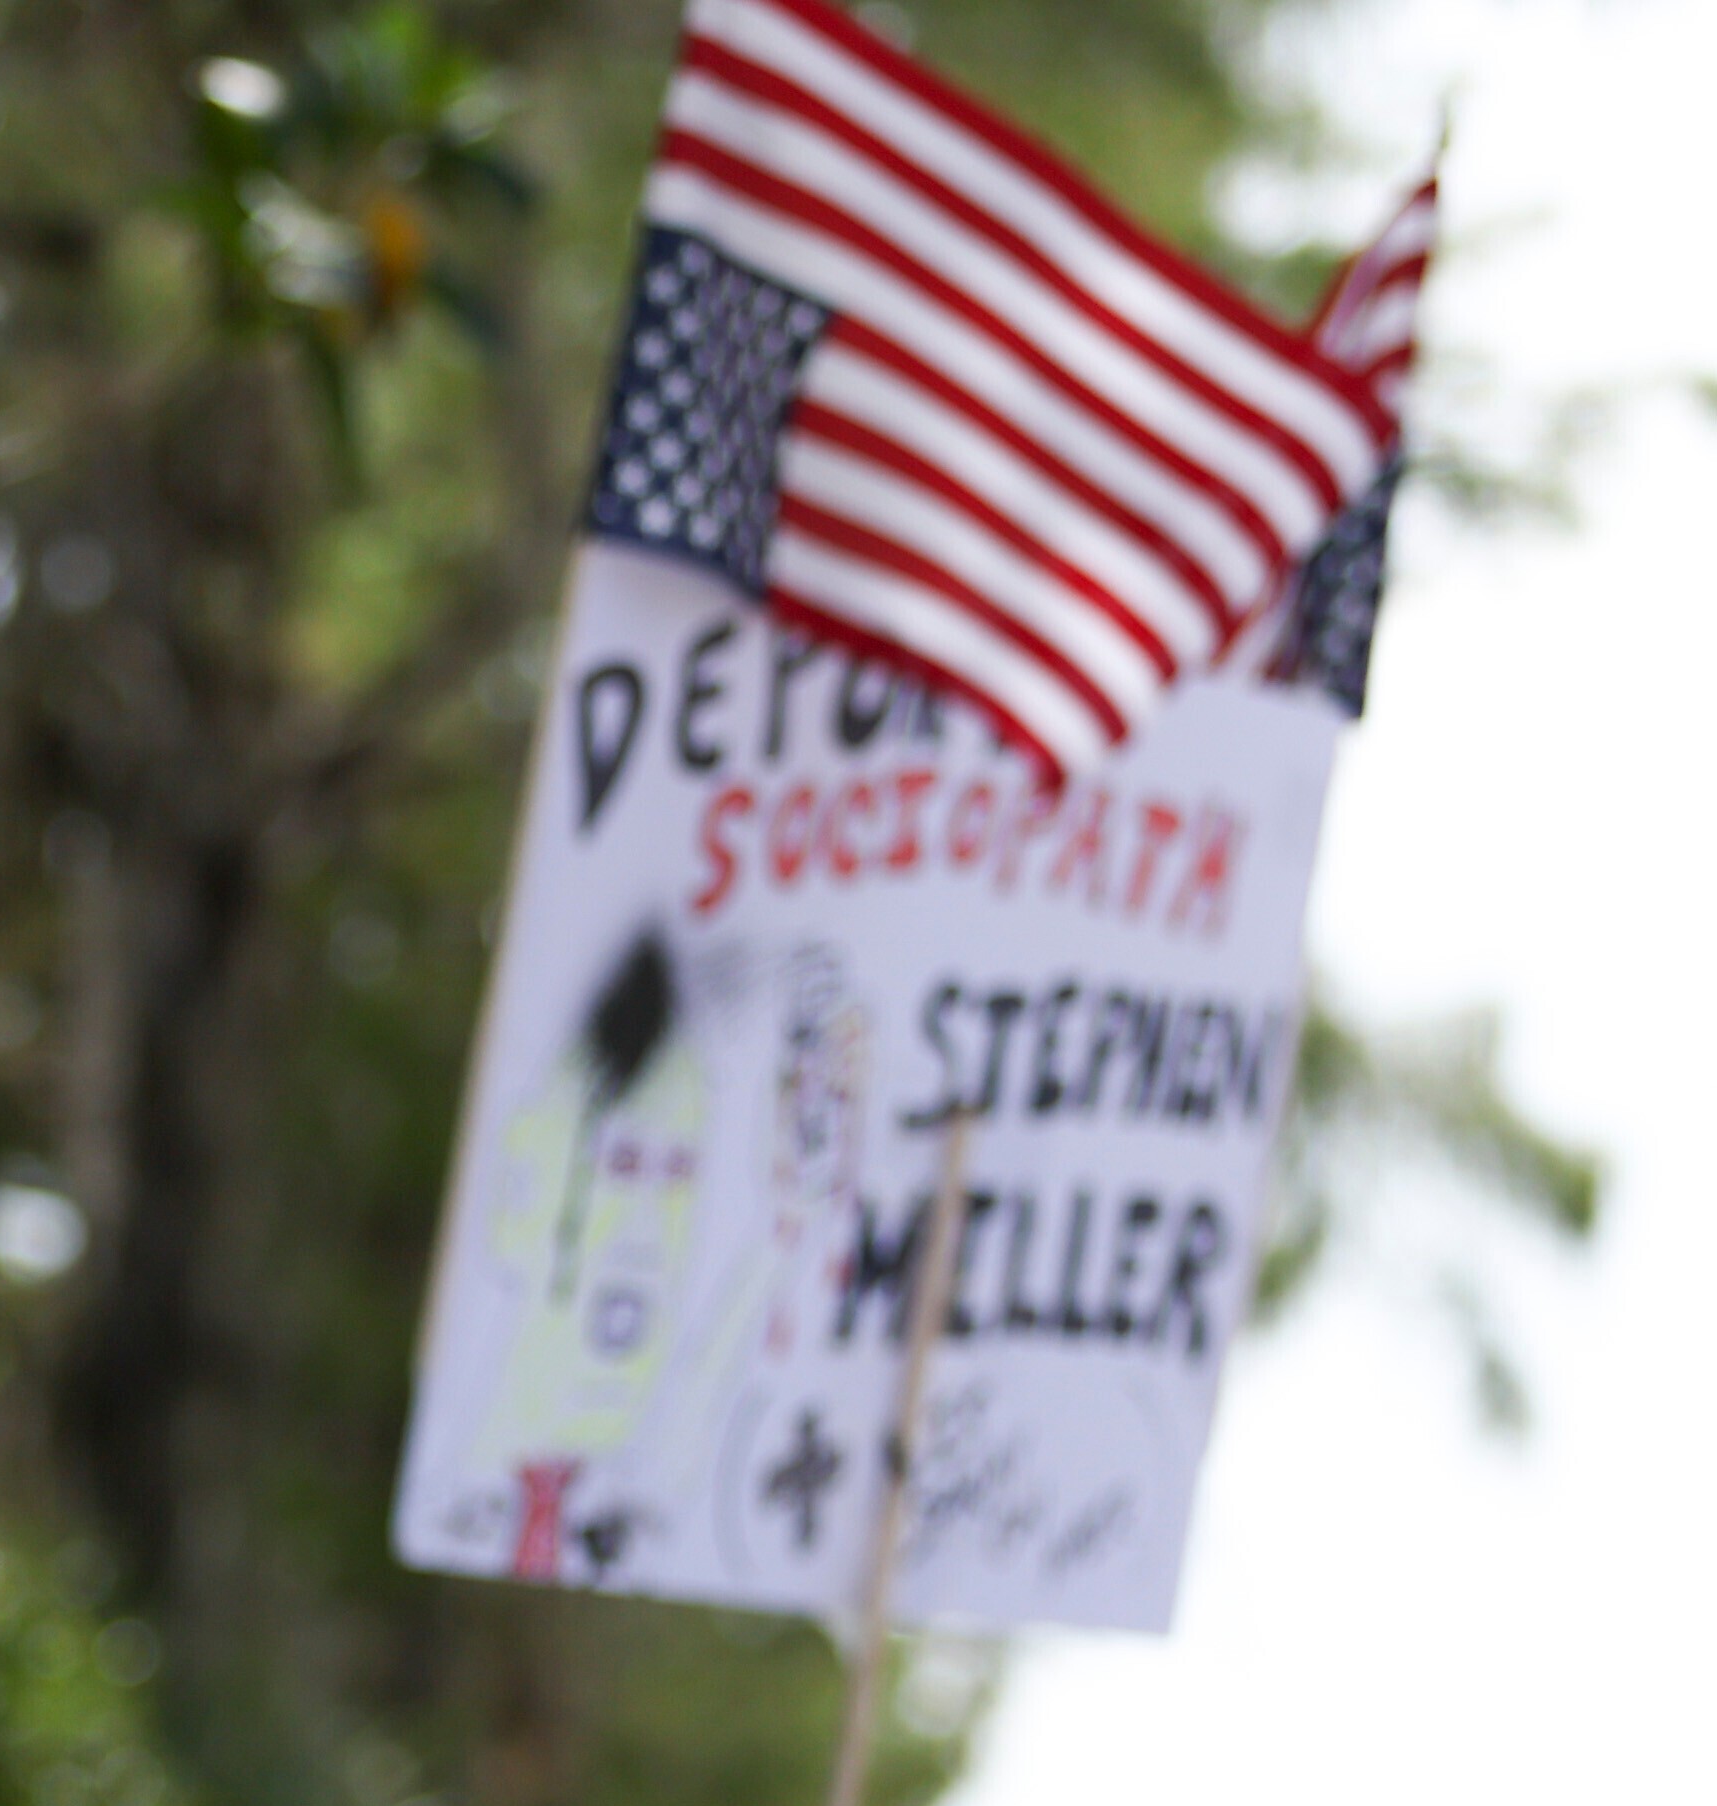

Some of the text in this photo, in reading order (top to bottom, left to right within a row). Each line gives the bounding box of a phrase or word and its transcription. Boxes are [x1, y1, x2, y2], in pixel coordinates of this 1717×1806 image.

[578, 618, 1006, 836] DEPO
[900, 978, 1274, 1130] STEPHEN
[832, 1192, 1226, 1360] MILLER
